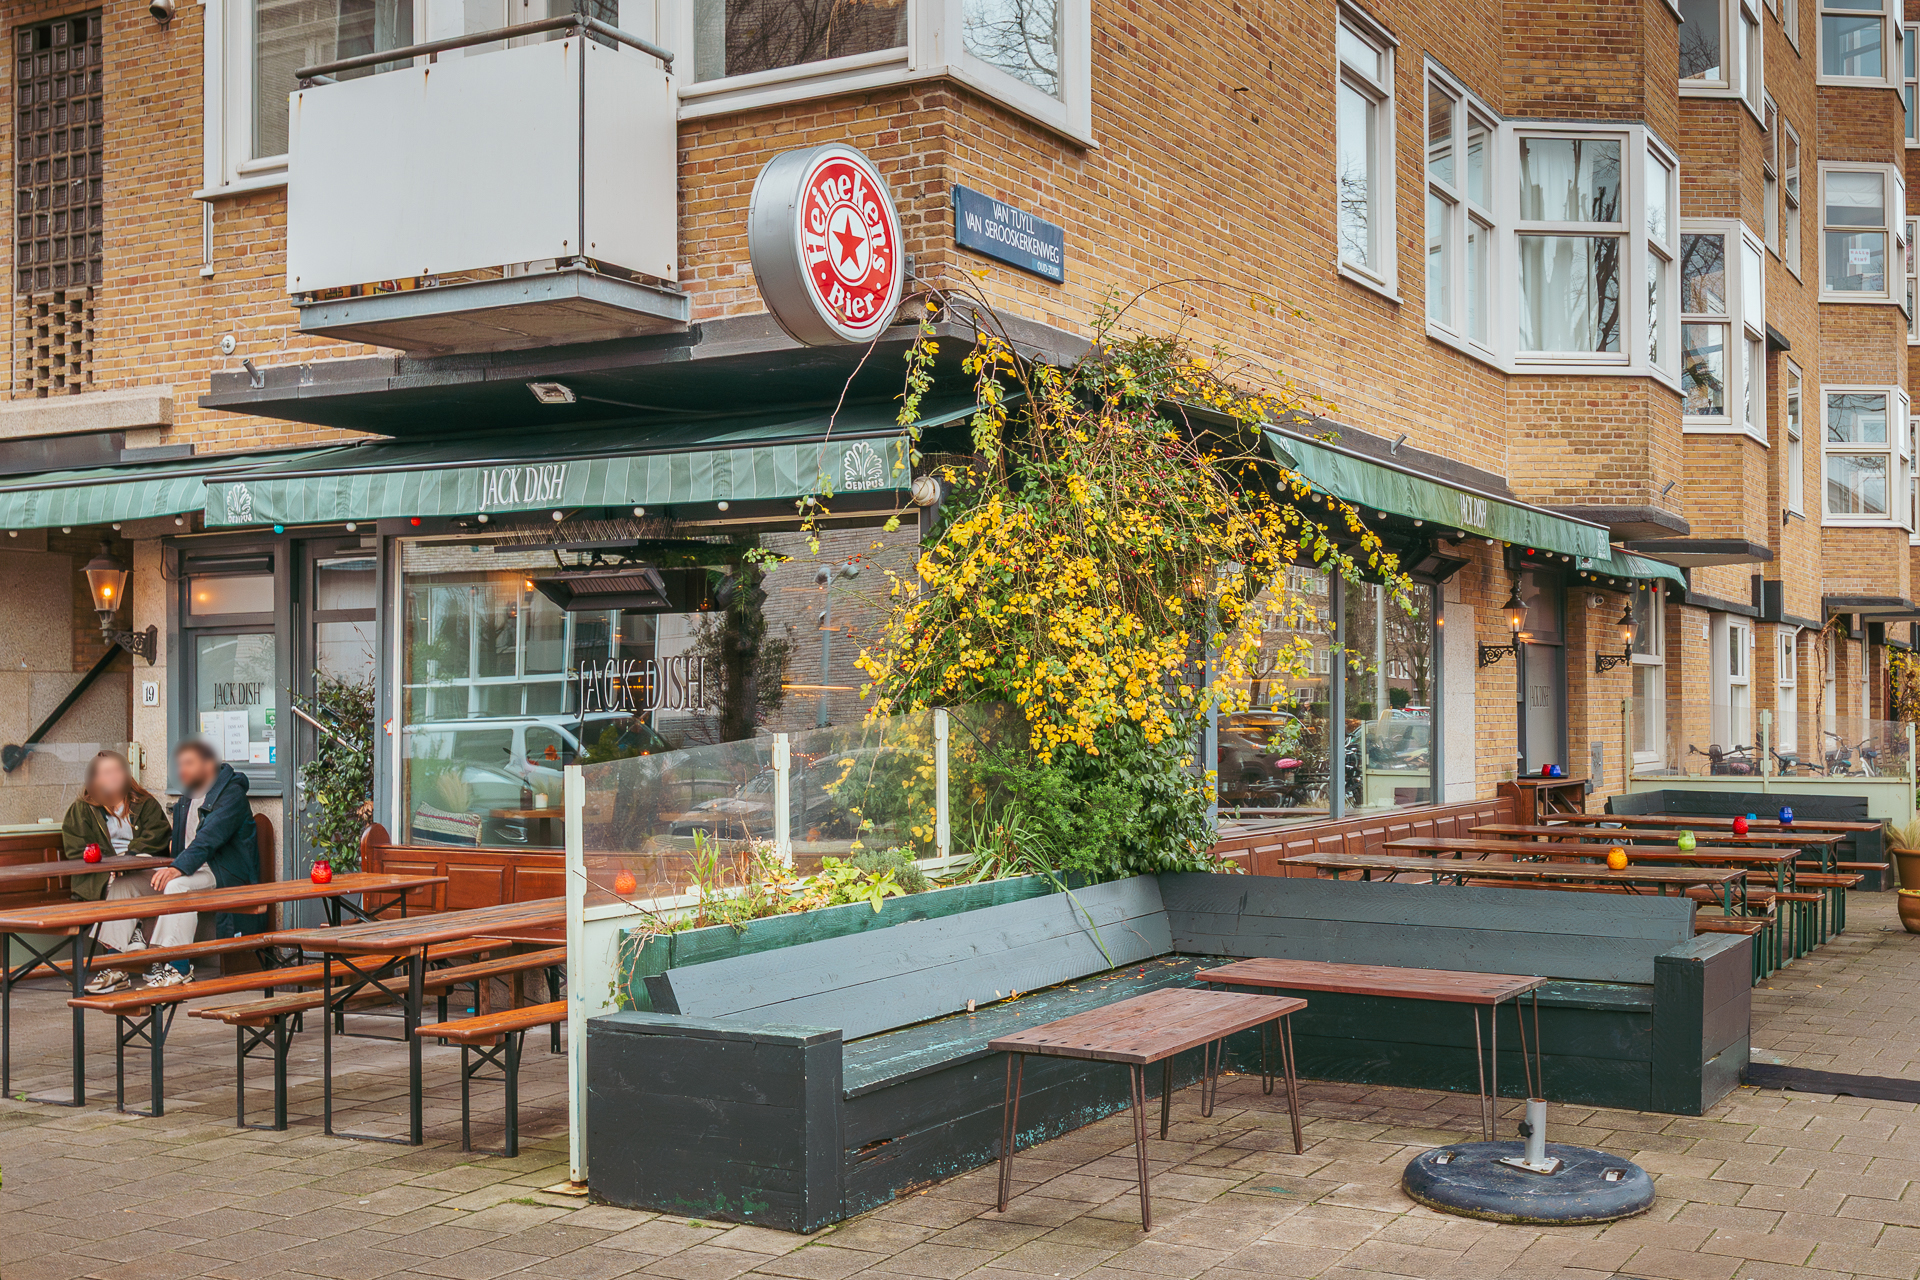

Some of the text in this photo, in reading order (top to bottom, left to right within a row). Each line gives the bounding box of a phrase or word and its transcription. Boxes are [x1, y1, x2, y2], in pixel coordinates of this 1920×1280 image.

[805, 170, 890, 273] Heineken's
[992, 202, 1035, 234] VAN TUYLL
[965, 211, 1059, 263] VAN SEROOSKERKENWEG
[1037, 261, 1059, 277] OUD-ZUID
[827, 281, 875, 318] Bier
[479, 464, 567, 511] JACK DISH
[845, 479, 884, 490] OEDIPUS
[145, 685, 155, 701] 19
[214, 682, 261, 709] JACK DISH
[573, 655, 706, 719] JACK DISH
